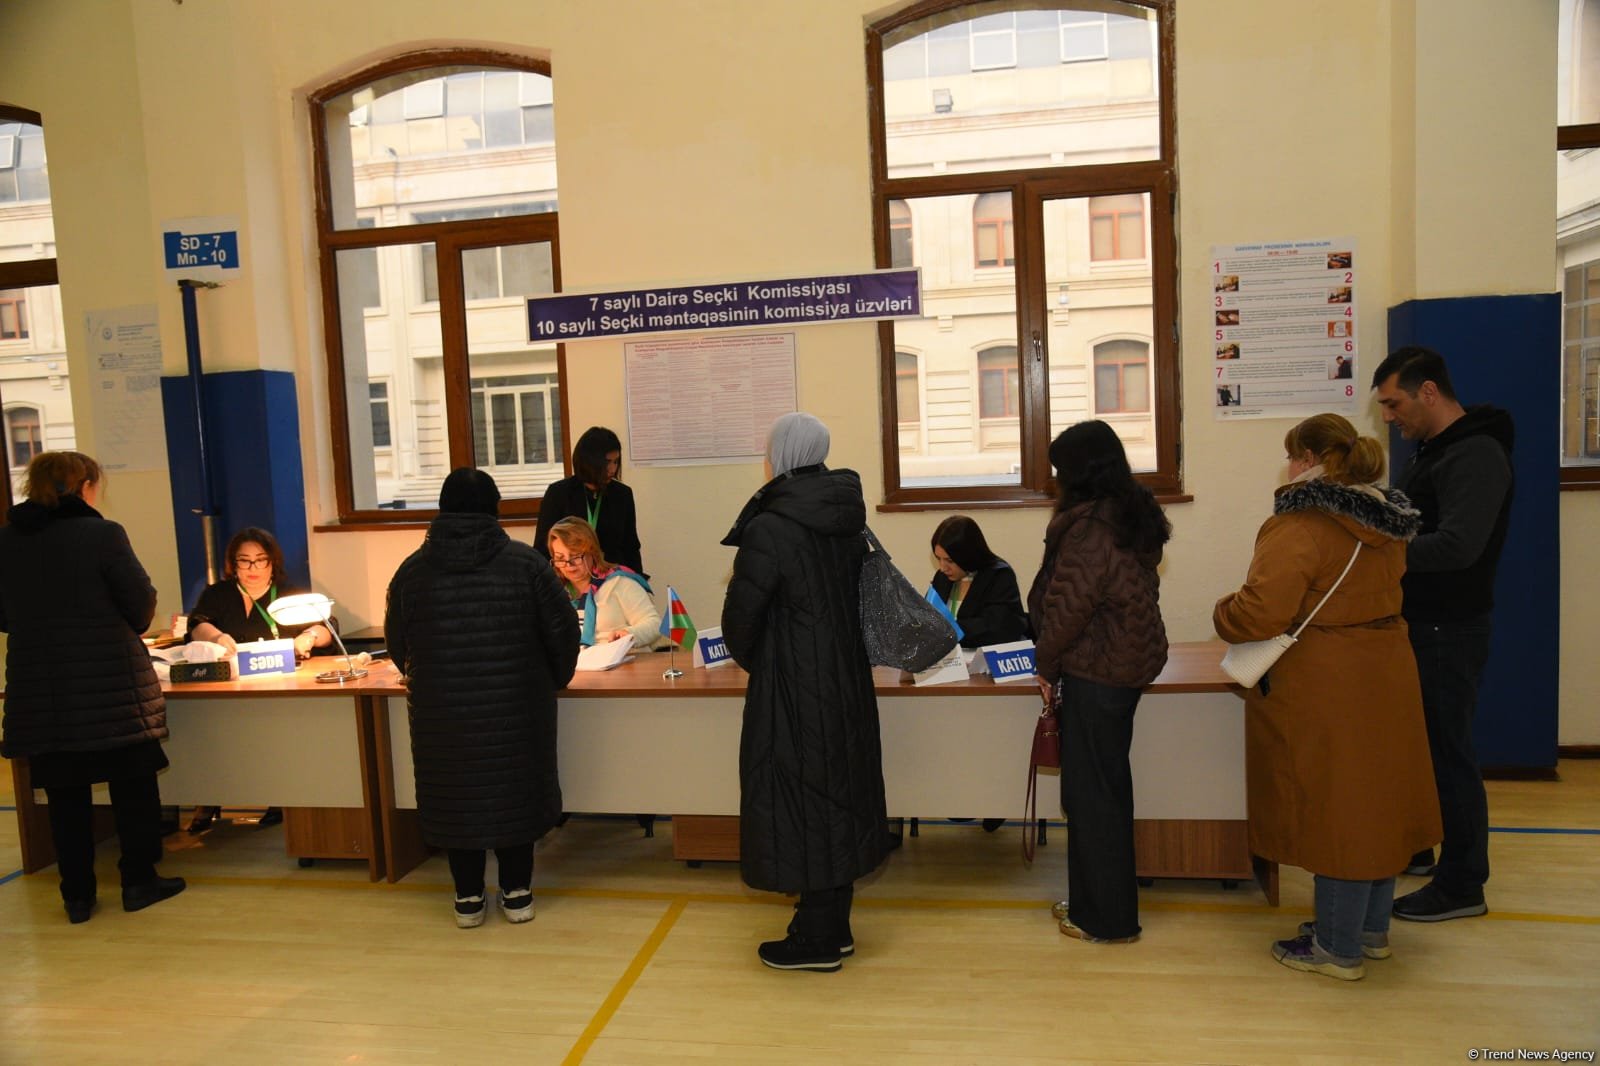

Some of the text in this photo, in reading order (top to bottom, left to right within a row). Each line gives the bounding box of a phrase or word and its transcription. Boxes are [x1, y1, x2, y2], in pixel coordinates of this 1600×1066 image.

[180, 237, 200, 250] SD
[212, 235, 221, 248] 7
[177, 252, 198, 265] Mn
[210, 249, 226, 262] 10
[1214, 262, 1220, 273] 1
[1344, 272, 1353, 284] 2
[589, 281, 851, 313] 7 saylı Dairə Seçki Komissiyası
[1215, 296, 1223, 307] 3
[536, 296, 912, 336] 10 saylı Seçki məntəqəsinin komissiya üzvləri
[1344, 306, 1353, 318] 4
[1215, 329, 1223, 341] 5
[1344, 340, 1353, 352] 6
[1216, 367, 1223, 378] 7
[1345, 385, 1353, 397] 8
[707, 639, 730, 660] KATİ
[249, 654, 284, 671] SƏDR
[997, 653, 1033, 674] KATİB
